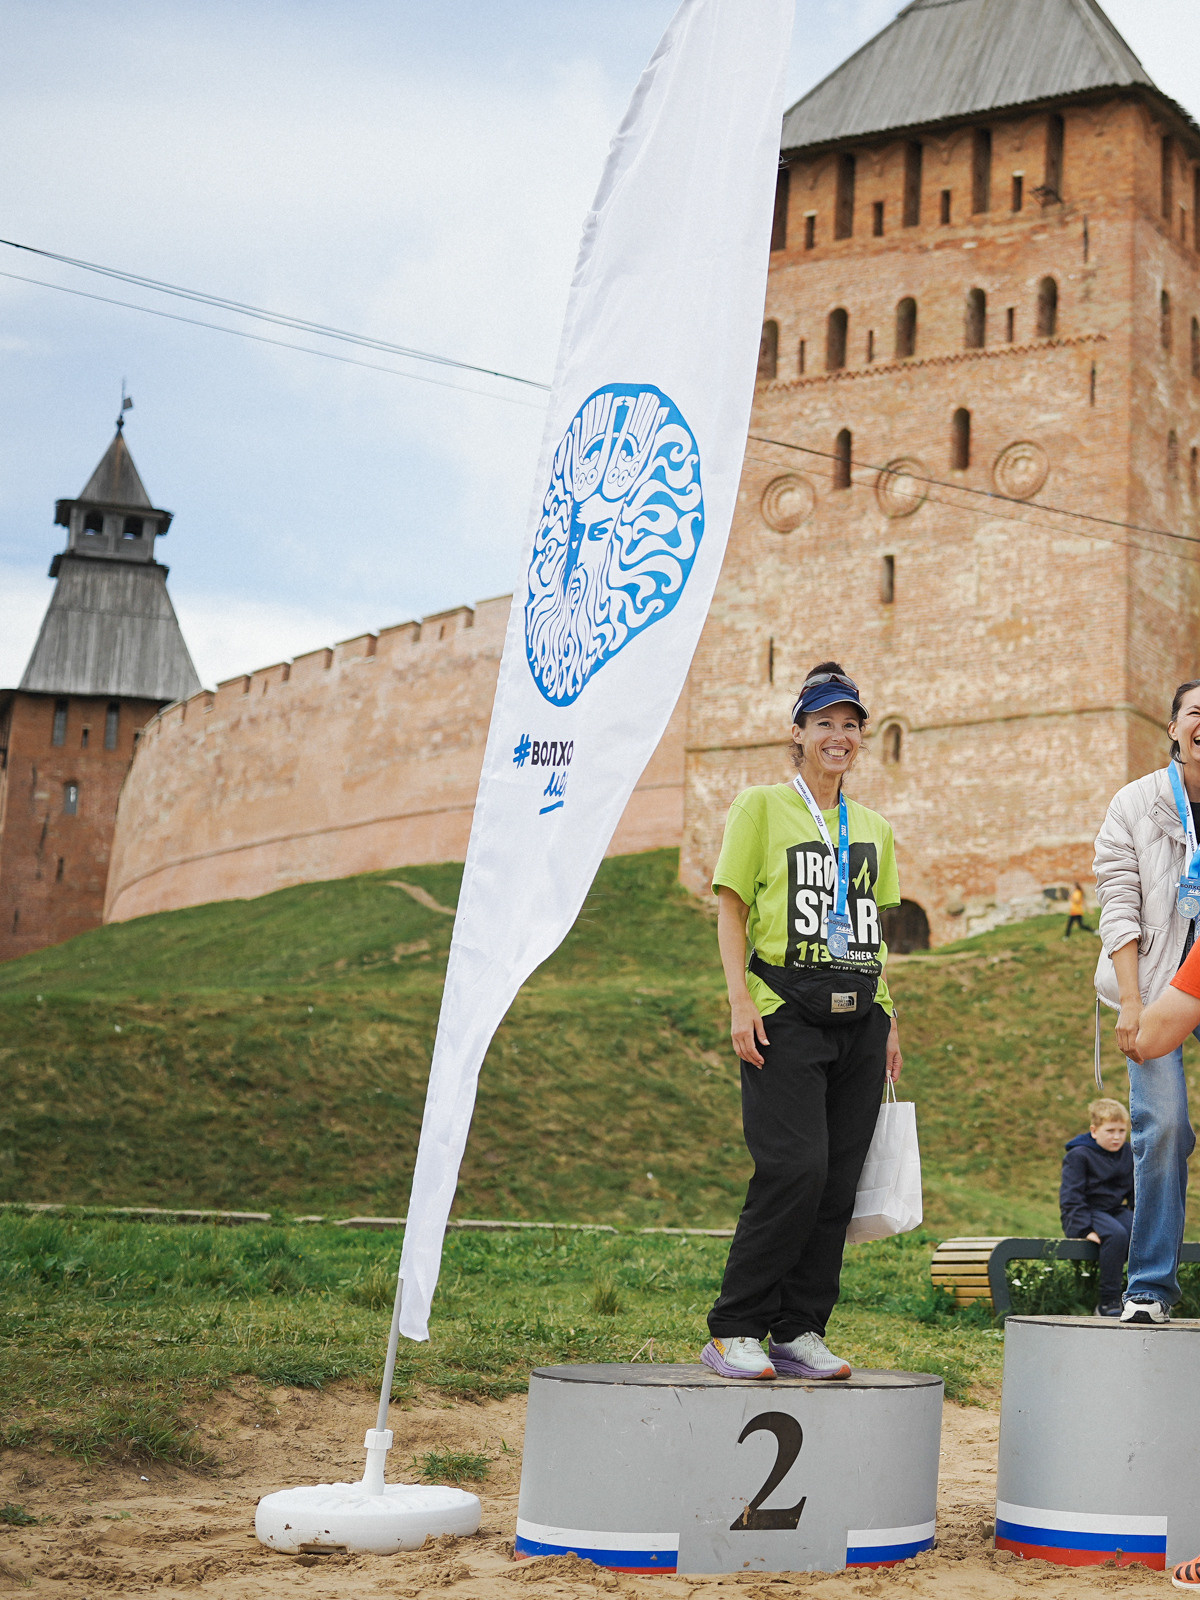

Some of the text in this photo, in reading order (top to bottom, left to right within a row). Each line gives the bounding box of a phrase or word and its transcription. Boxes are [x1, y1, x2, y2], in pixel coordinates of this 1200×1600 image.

[796, 852, 836, 890] IRO
[796, 941, 833, 962] 113
[730, 1411, 807, 1530] 2
